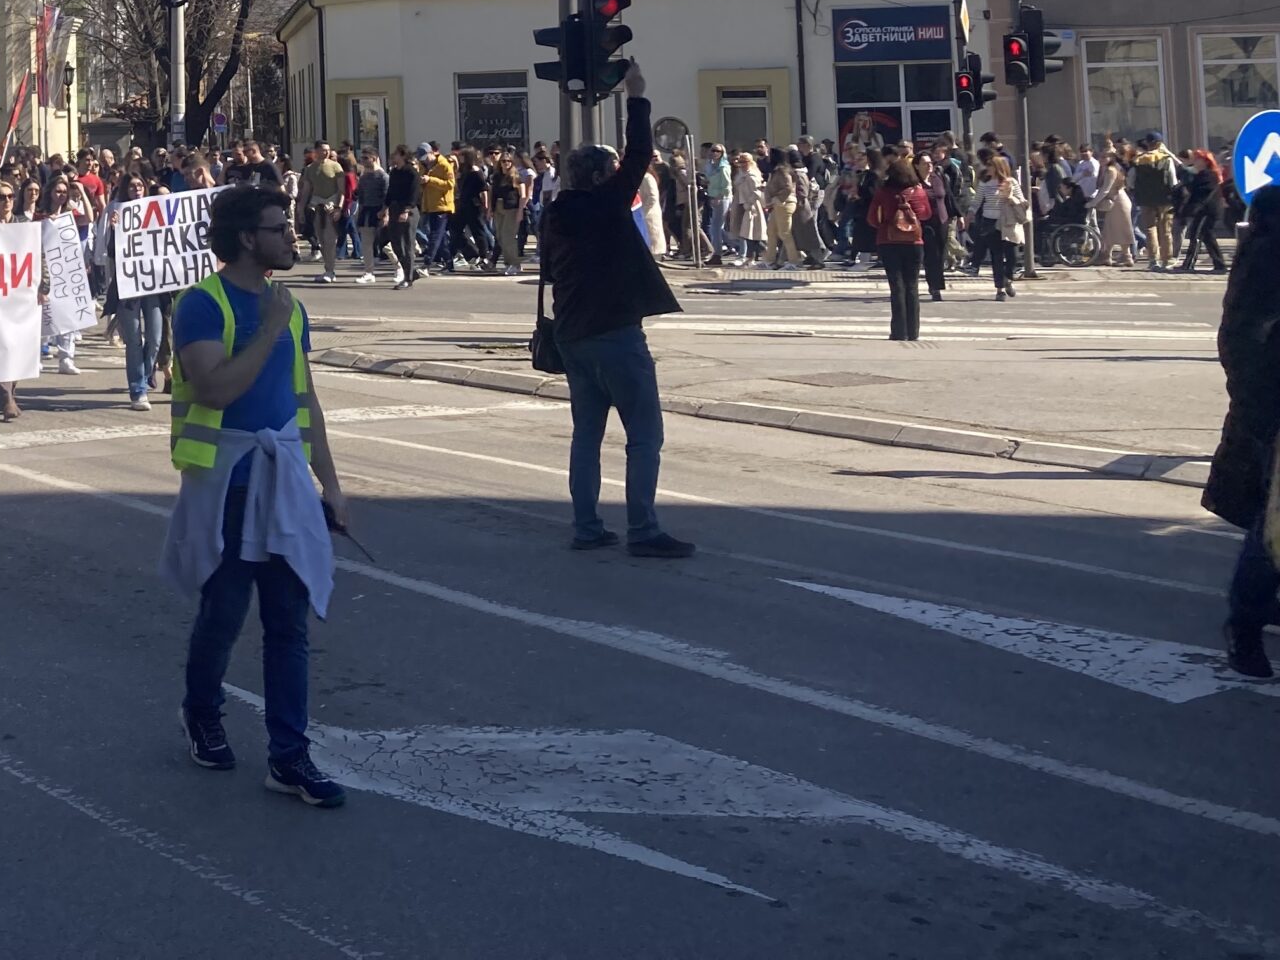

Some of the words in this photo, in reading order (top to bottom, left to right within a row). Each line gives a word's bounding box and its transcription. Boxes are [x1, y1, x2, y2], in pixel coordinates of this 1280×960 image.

[844, 27, 916, 43] ЗАВЕТНИЦИ
[918, 27, 945, 39] НИШ
[122, 230, 144, 258] ЈЕ
[46, 246, 69, 299] ПОЛУ
[122, 252, 215, 292] ЧУДНА
